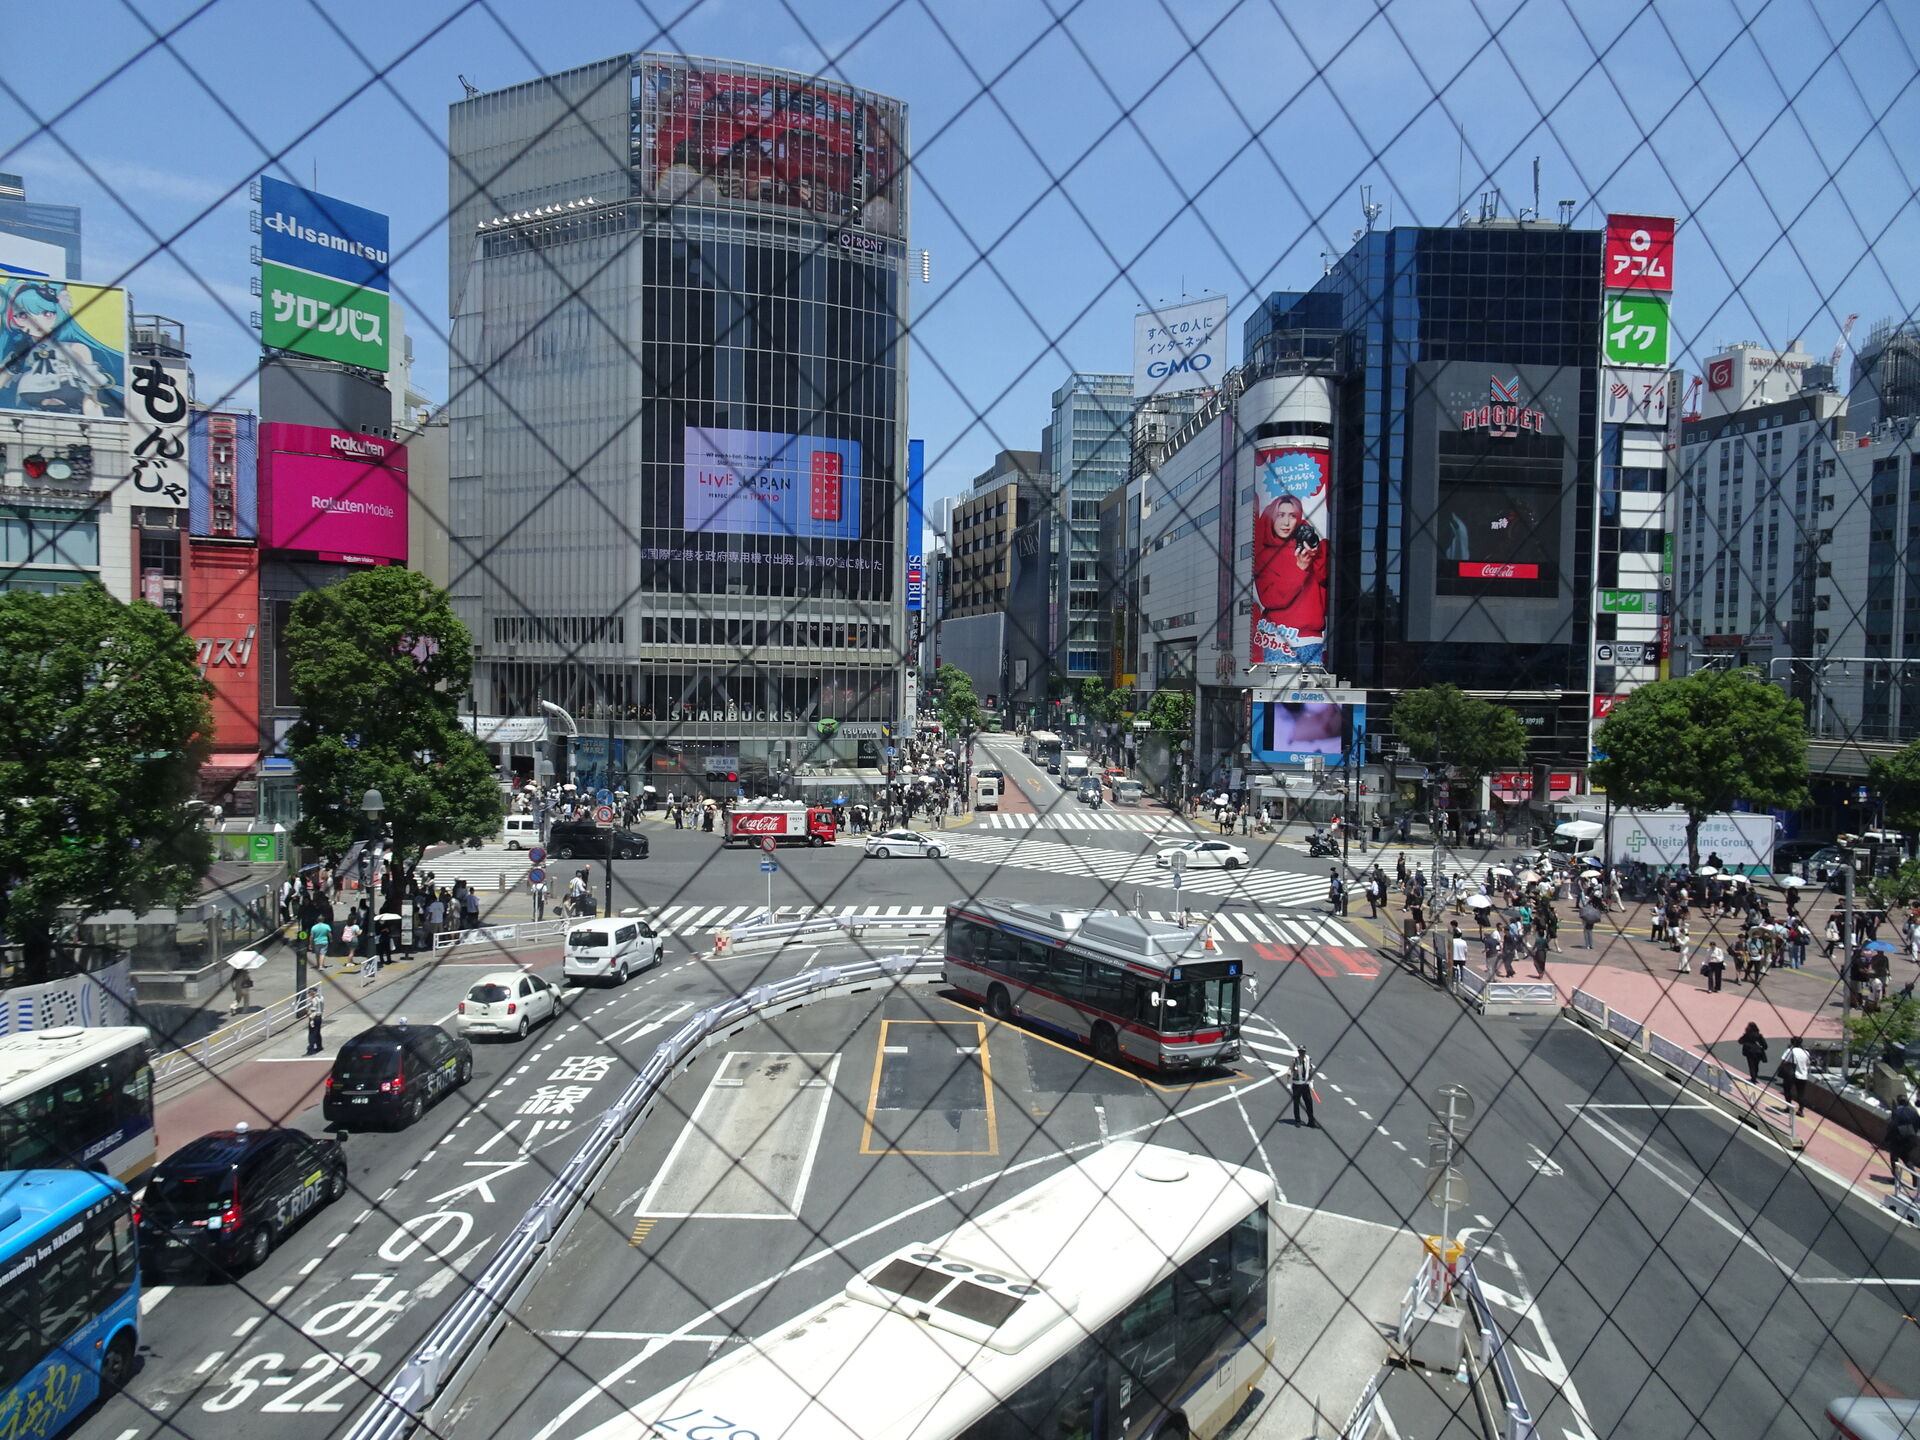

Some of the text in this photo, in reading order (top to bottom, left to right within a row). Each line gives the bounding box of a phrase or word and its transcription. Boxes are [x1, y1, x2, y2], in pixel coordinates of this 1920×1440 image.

[264, 211, 388, 264] Hisamitsu
[1613, 254, 1666, 278] アコム
[271, 288, 383, 347] サロンパス
[1147, 316, 1214, 341] すべての人に
[1147, 333, 1212, 356] インターネット
[1146, 353, 1212, 379] GMO
[1463, 405, 1545, 434] MAGNET
[131, 359, 188, 506] もんじゃ
[330, 434, 385, 457] Rakuten
[699, 471, 791, 491] LIVE JAPAN
[311, 495, 394, 519] Rakuten Mobile
[749, 492, 781, 503] TOKYO
[1604, 592, 1641, 607] レイク
[670, 710, 794, 723] STARBUCKS
[842, 727, 878, 736] TSUTAYA
[737, 815, 780, 832] Coca-Cola
[1721, 837, 1754, 850] Group
[276, 1176, 329, 1232] S.RIDE
[37, 1244, 53, 1261] bus
